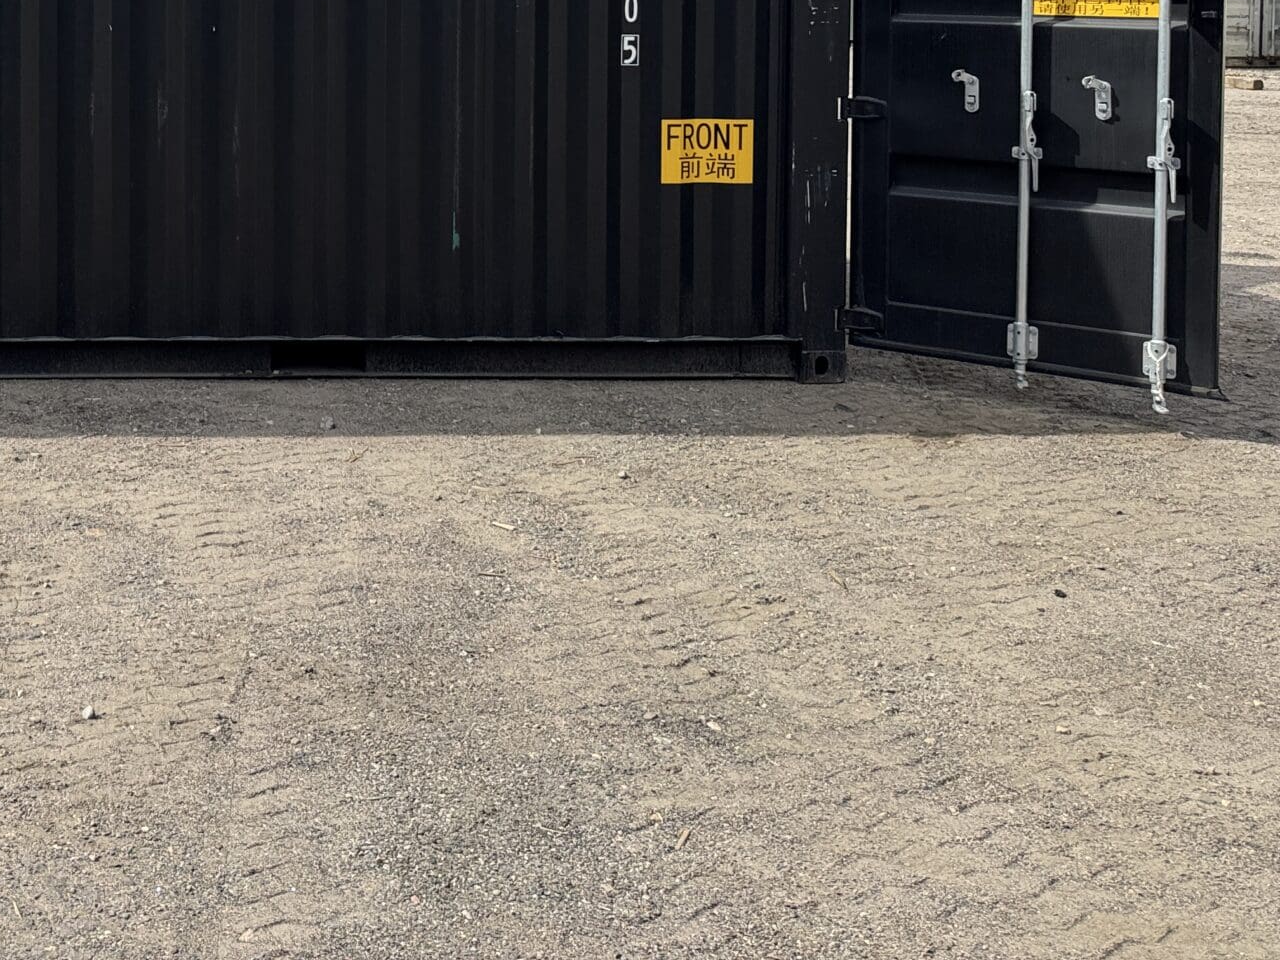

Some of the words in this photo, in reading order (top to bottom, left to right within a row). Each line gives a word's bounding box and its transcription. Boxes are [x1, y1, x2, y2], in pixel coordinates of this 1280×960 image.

[621, 35, 639, 65] 5
[666, 122, 749, 151] FRONT
[678, 151, 736, 180] 前端
